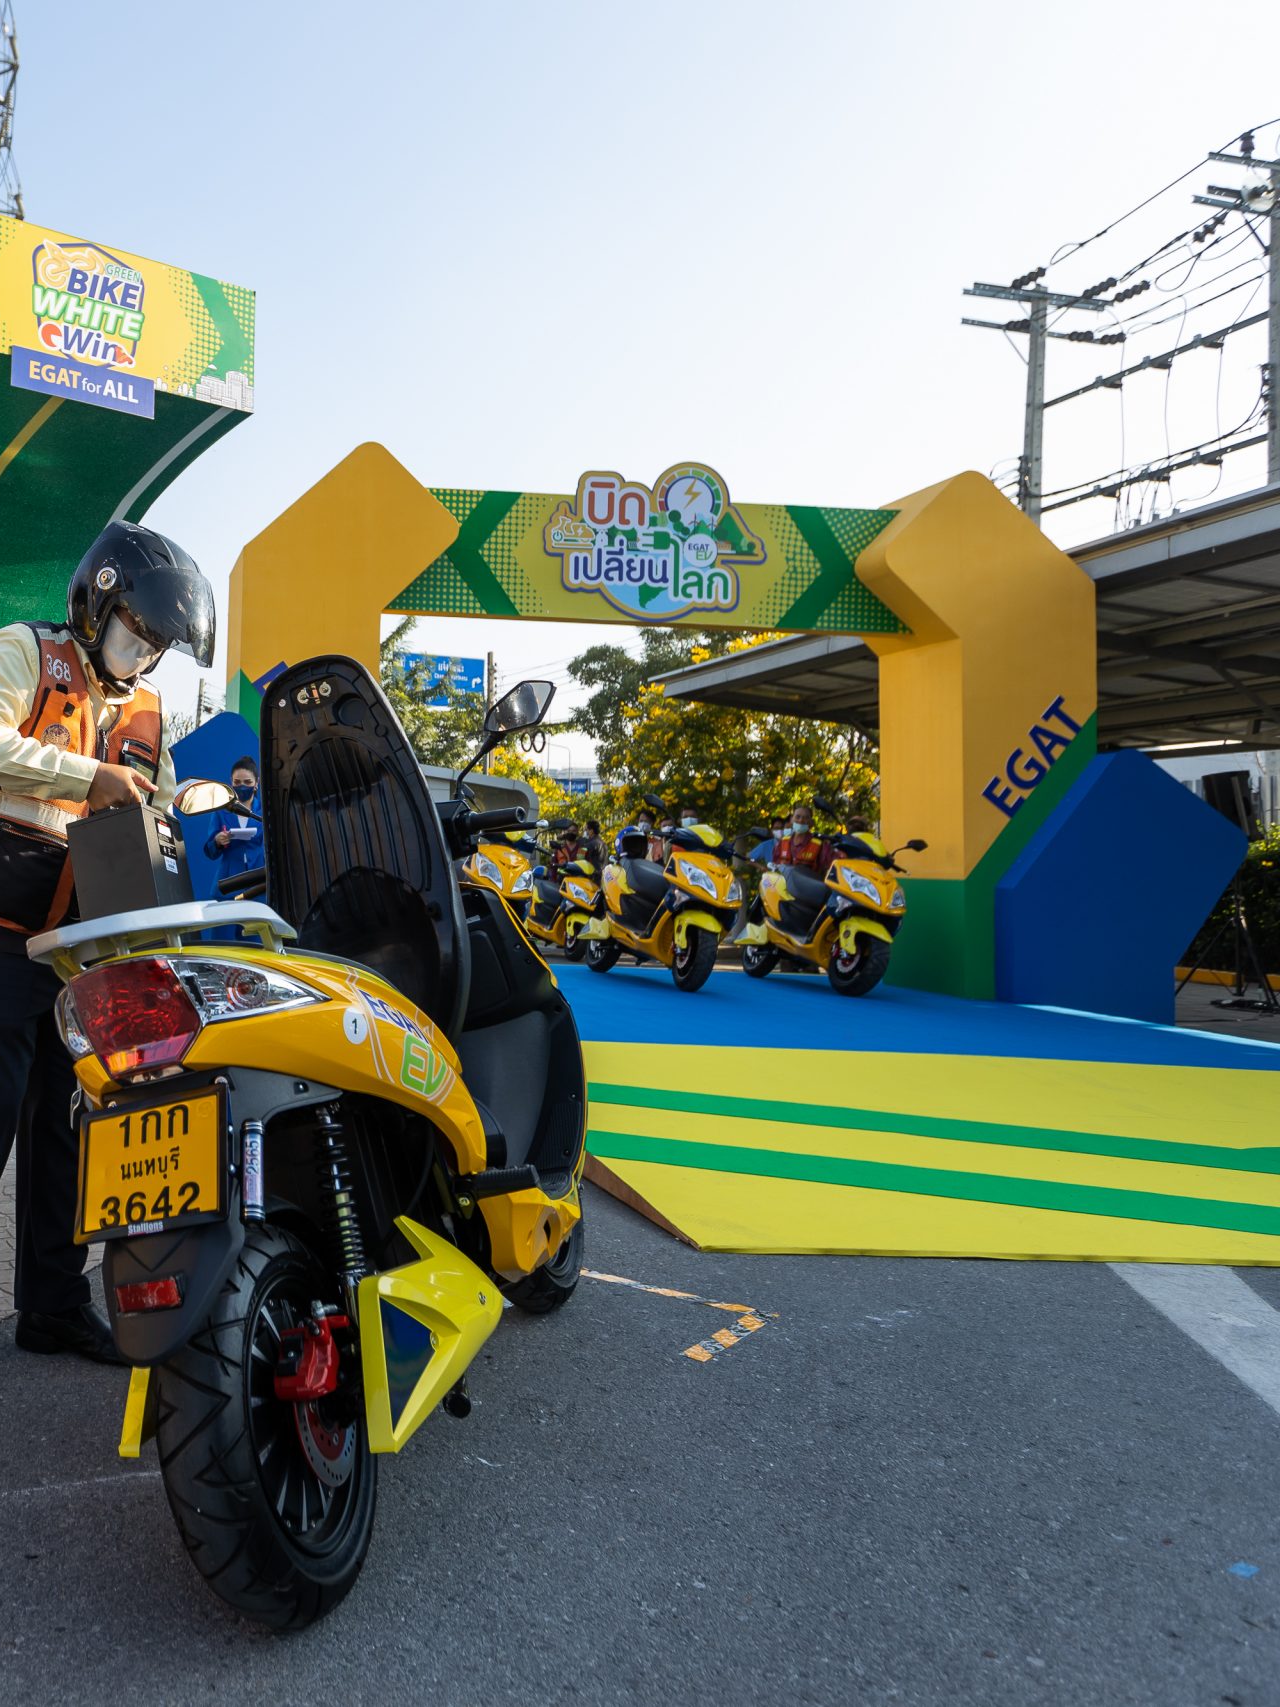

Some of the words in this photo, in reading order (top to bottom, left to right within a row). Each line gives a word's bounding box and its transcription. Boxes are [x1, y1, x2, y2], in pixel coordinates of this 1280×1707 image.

[67, 268, 140, 311] BIKE
[105, 263, 141, 284] GREEN
[32, 284, 145, 341] WHITE
[29, 359, 81, 389] EGAT
[81, 377, 102, 395] for
[103, 379, 138, 404] ALL
[587, 481, 646, 527] บิด
[687, 542, 710, 551] EGAT
[46, 653, 72, 682] 368
[982, 694, 1082, 819] EGAT
[351, 1018, 358, 1035] 1
[400, 1031, 448, 1097] EV
[119, 1103, 189, 1148] 1กก
[120, 1145, 180, 1181] นนทบุรี
[99, 1181, 201, 1230] 3642
